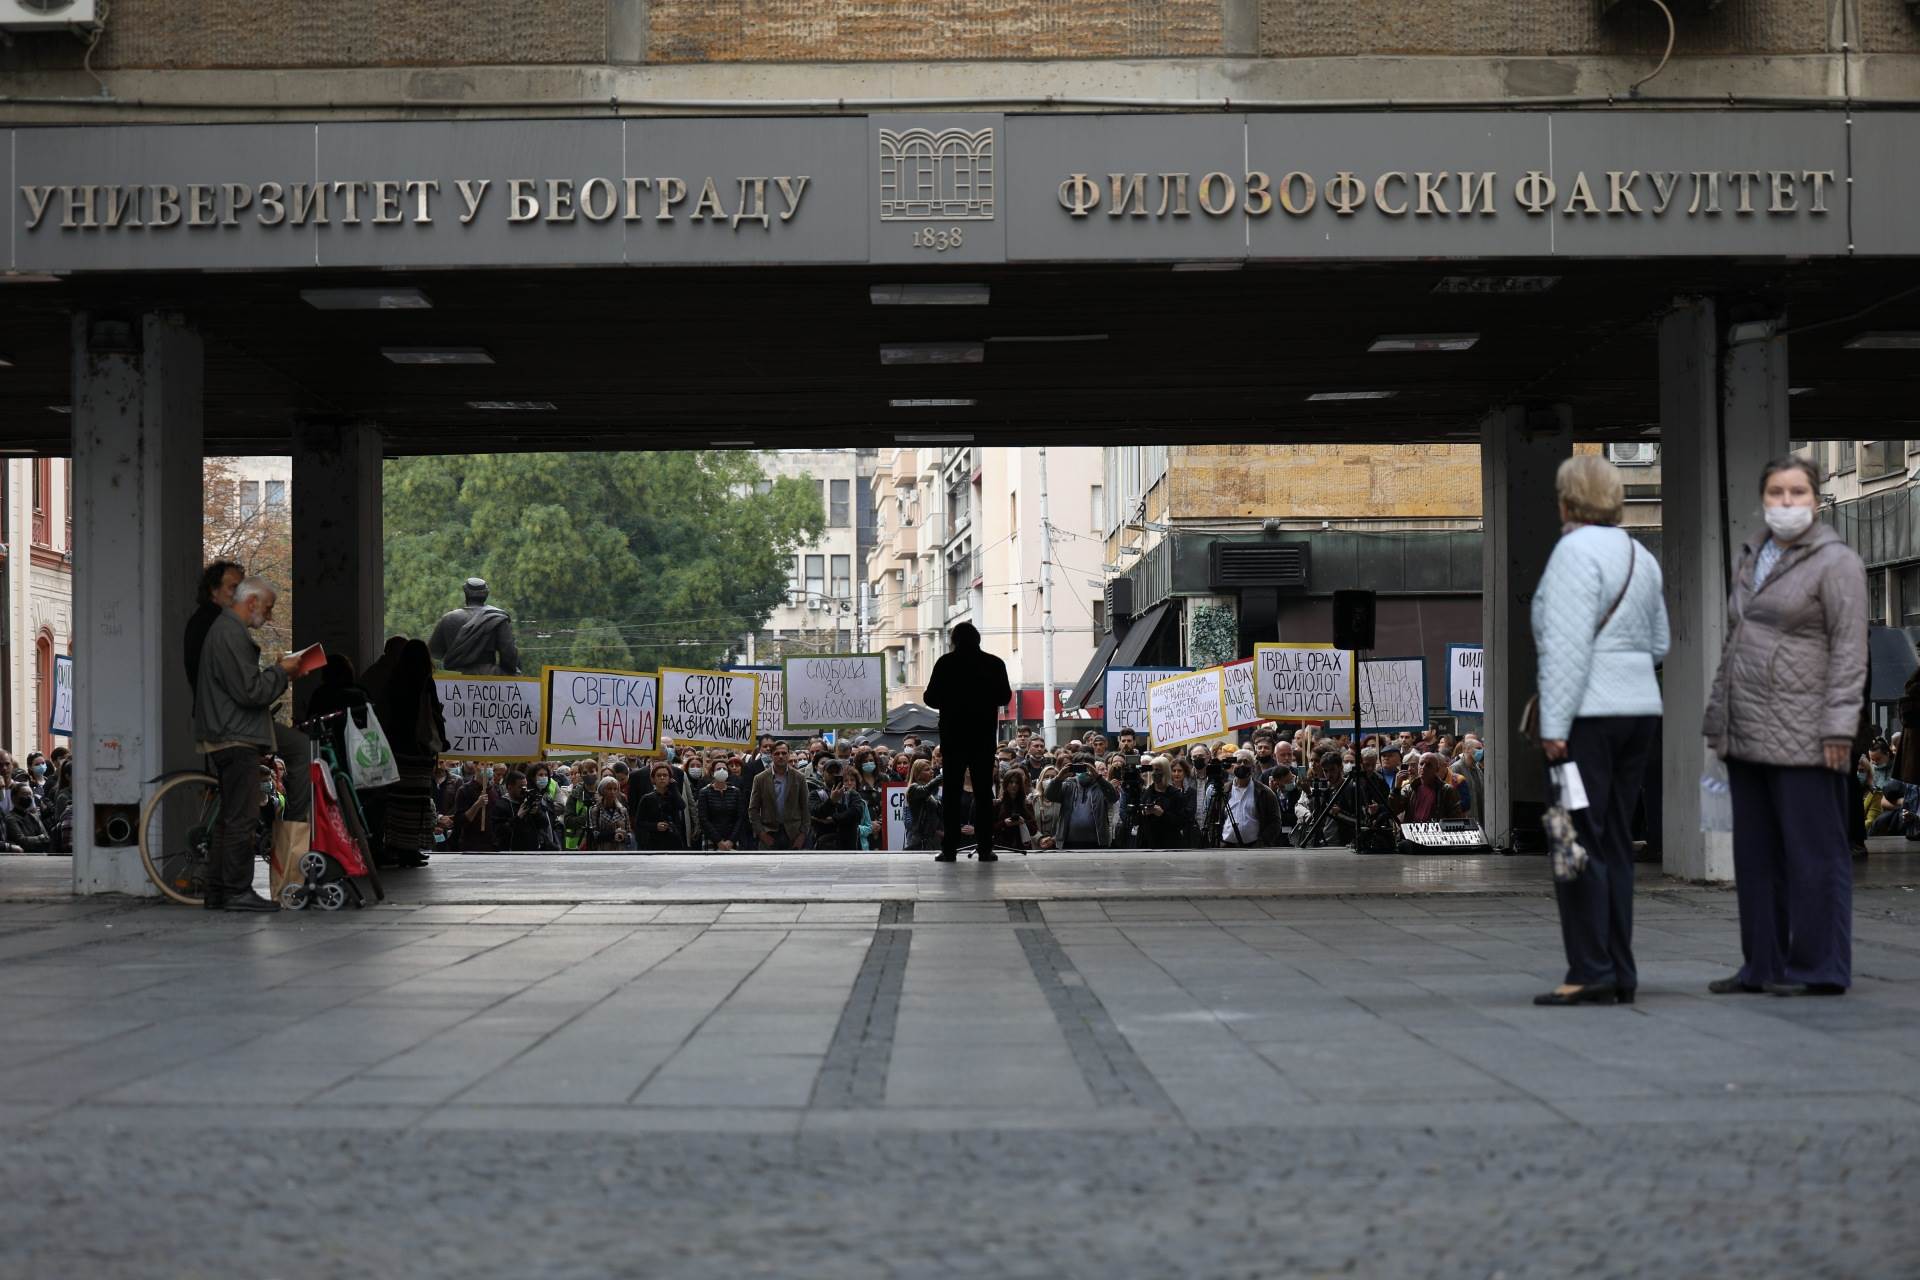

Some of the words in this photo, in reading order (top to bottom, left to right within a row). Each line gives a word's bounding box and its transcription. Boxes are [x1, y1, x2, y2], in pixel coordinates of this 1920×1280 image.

[20, 179, 439, 229] УНИВЕРЗИТЕТ
[454, 179, 491, 223] У
[506, 176, 810, 230] БЕОГРАДУ
[1057, 170, 1497, 216] ФИЛОЗОФСКИ
[1514, 170, 1835, 214] ФАКУЛТЕТ
[912, 226, 962, 251] 1838
[1260, 652, 1291, 672] ТВРД
[1307, 652, 1342, 672] ОРАХ
[445, 684, 461, 700] LA
[467, 683, 521, 702] FACOLTÀ
[572, 677, 654, 707] СВЕТСКА
[685, 675, 733, 698] СТОП!
[1273, 672, 1340, 692] ФИЛОЛОГ
[454, 702, 465, 717] DI
[472, 702, 532, 720] FILOLOGIA
[1266, 692, 1344, 713] АНГЛИСТА
[464, 720, 488, 734] NON
[495, 720, 514, 735] STA
[562, 706, 577, 726] А
[598, 708, 653, 744] НАША
[453, 736, 498, 752] ZITTA
